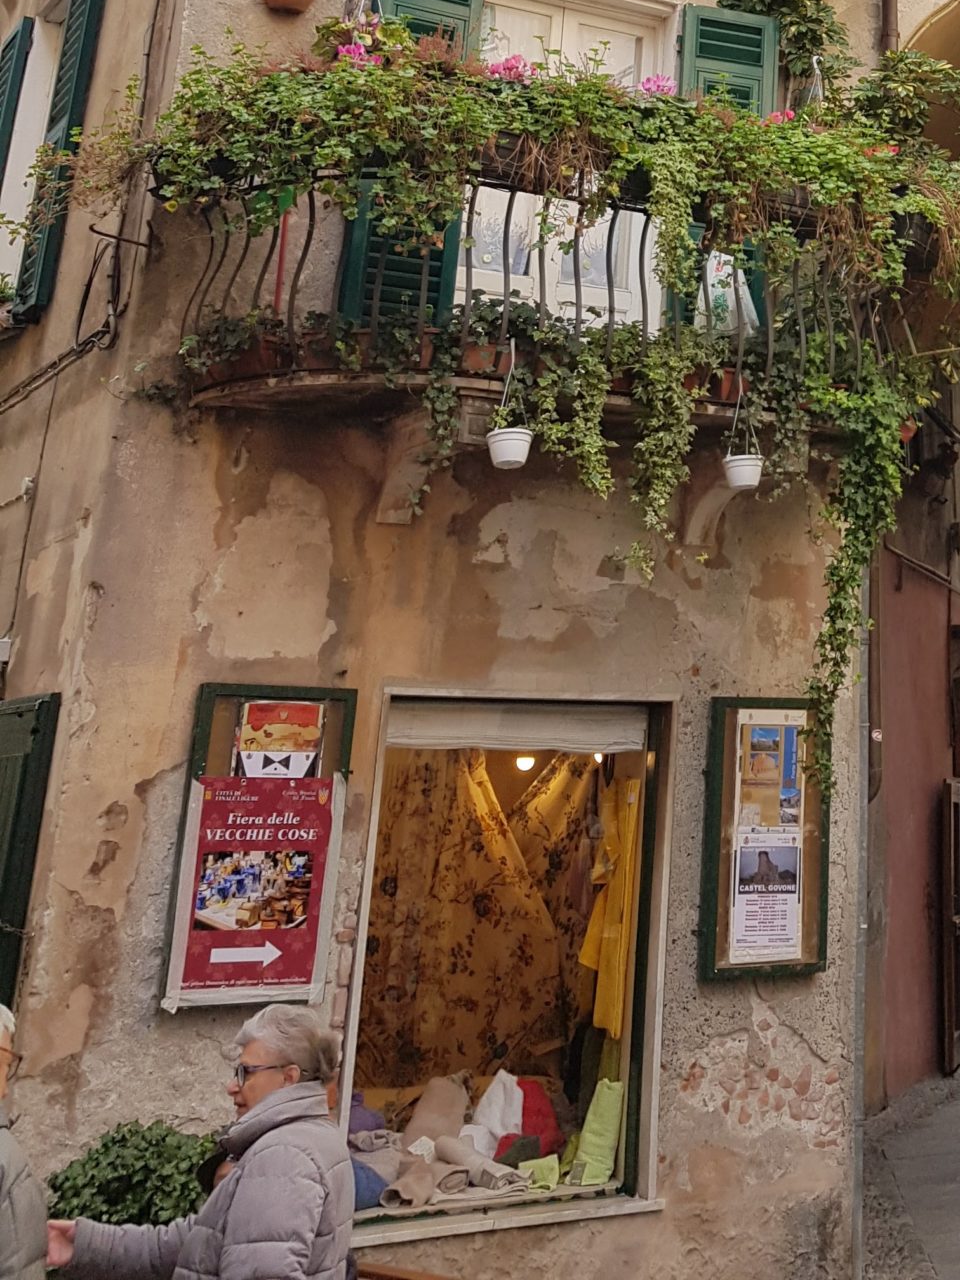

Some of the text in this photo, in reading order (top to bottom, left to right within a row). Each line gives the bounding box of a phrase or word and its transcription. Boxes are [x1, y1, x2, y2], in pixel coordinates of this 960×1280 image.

[227, 812, 301, 825] Fiera delle
[206, 828, 318, 841] VECCHIE COSE
